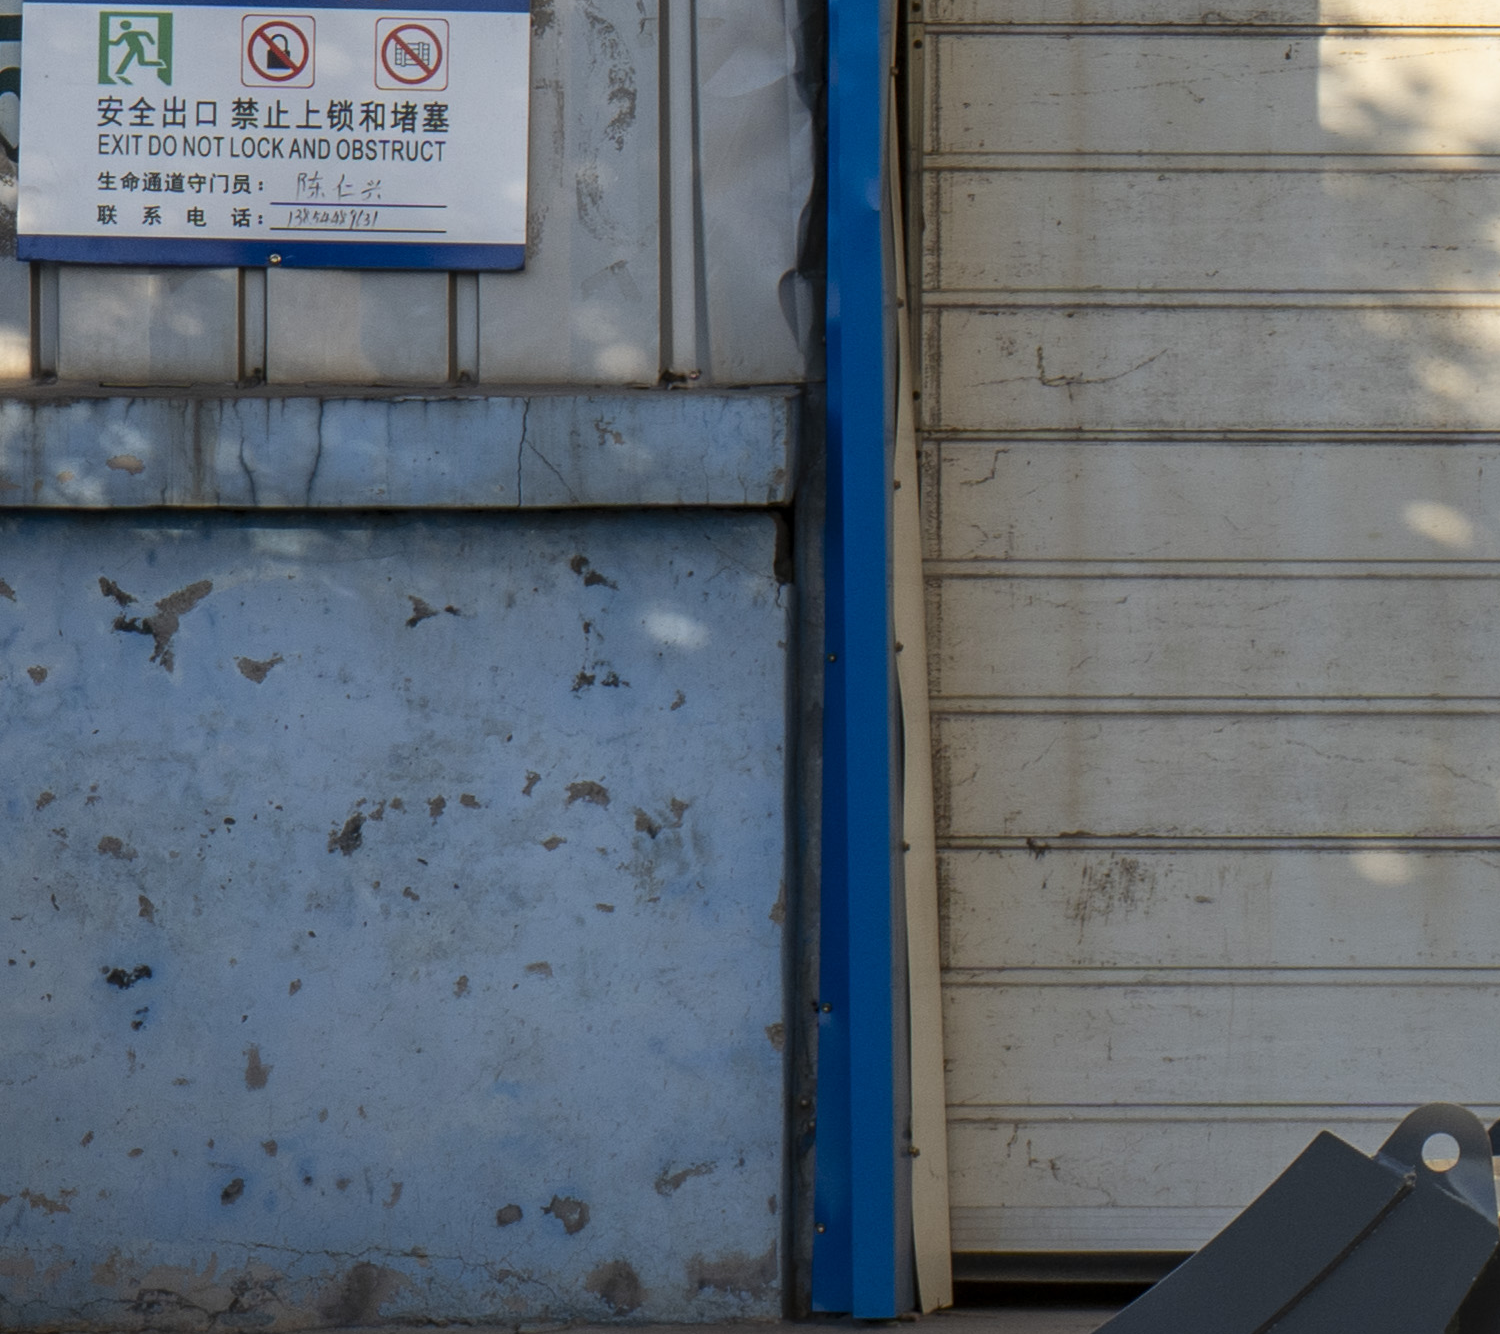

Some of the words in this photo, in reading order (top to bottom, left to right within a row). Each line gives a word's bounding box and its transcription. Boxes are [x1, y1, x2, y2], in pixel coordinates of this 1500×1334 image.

[97, 95, 217, 129] 安全出口
[231, 97, 450, 134] 禁止上锁和堵塞
[98, 133, 143, 156] EXIT
[148, 134, 177, 157] DO
[183, 135, 225, 158] NOT
[230, 136, 284, 159] LOCK
[288, 137, 331, 160] AND
[336, 138, 446, 162] OBSTRUCT
